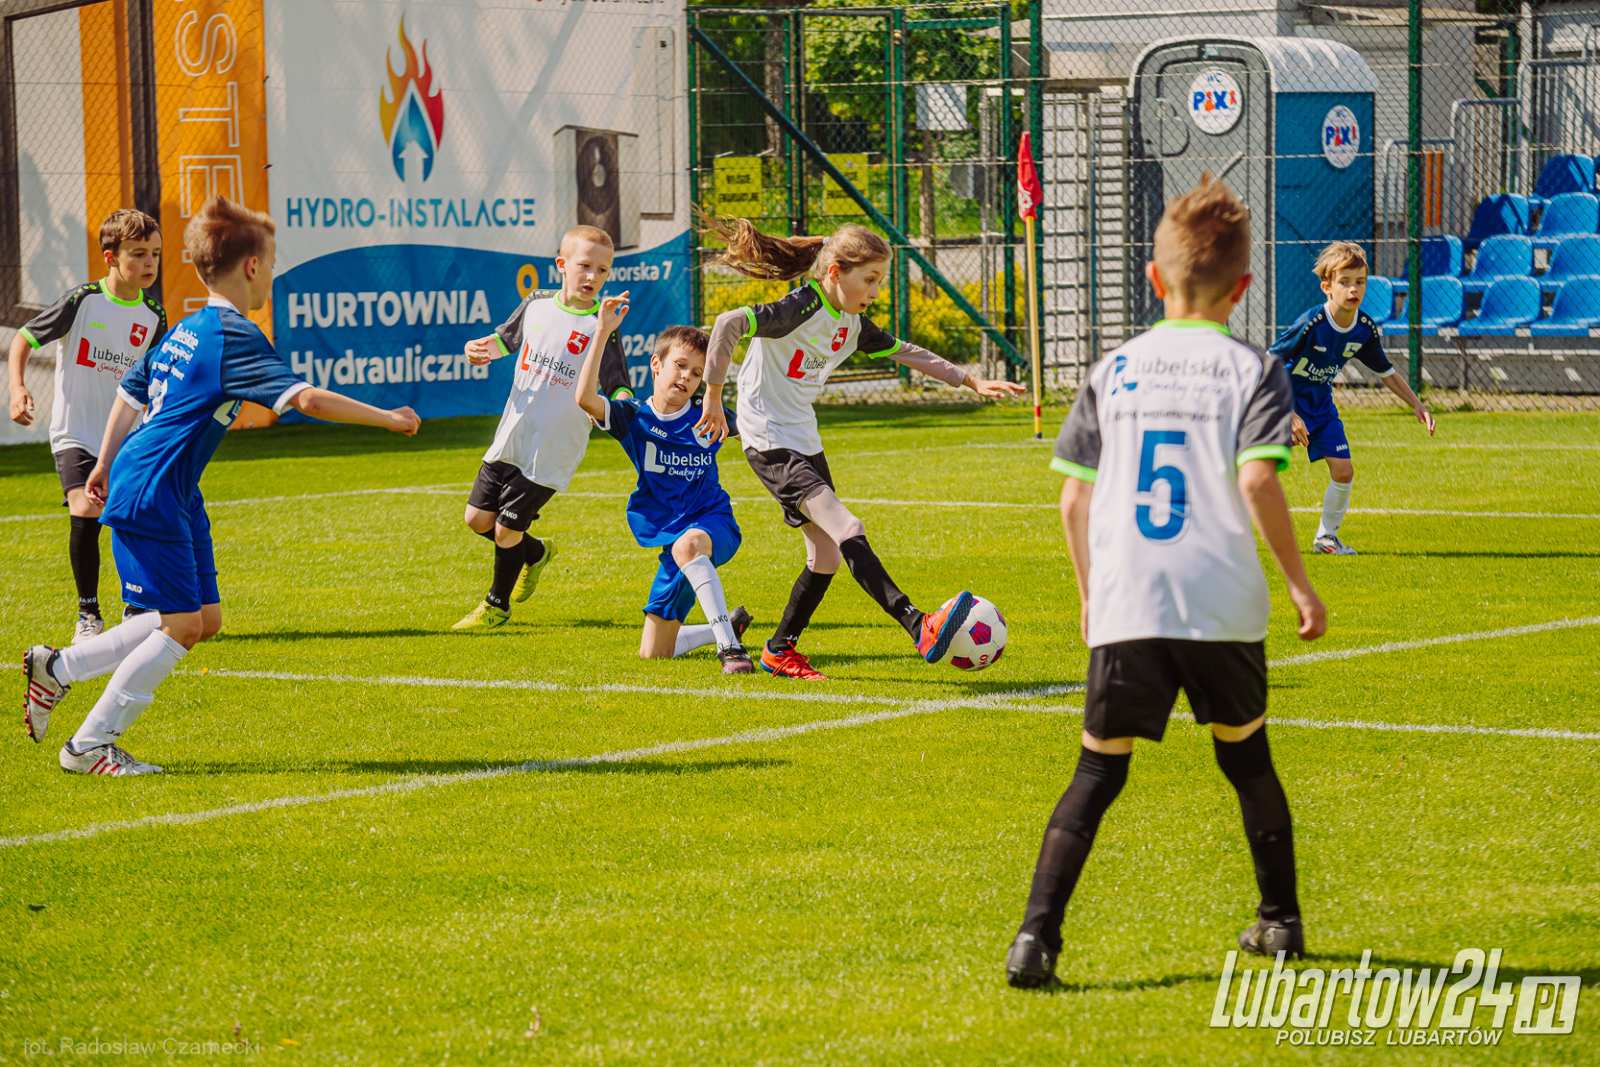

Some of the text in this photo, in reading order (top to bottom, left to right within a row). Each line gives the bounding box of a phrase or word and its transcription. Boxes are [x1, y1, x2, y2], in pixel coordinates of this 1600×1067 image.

[287, 197, 536, 228] HYDRO-INSTALACJE
[662, 260, 673, 281] 7
[288, 290, 492, 329] HURTOWNIA
[650, 426, 669, 438] JAKO
[1135, 430, 1188, 541] 5
